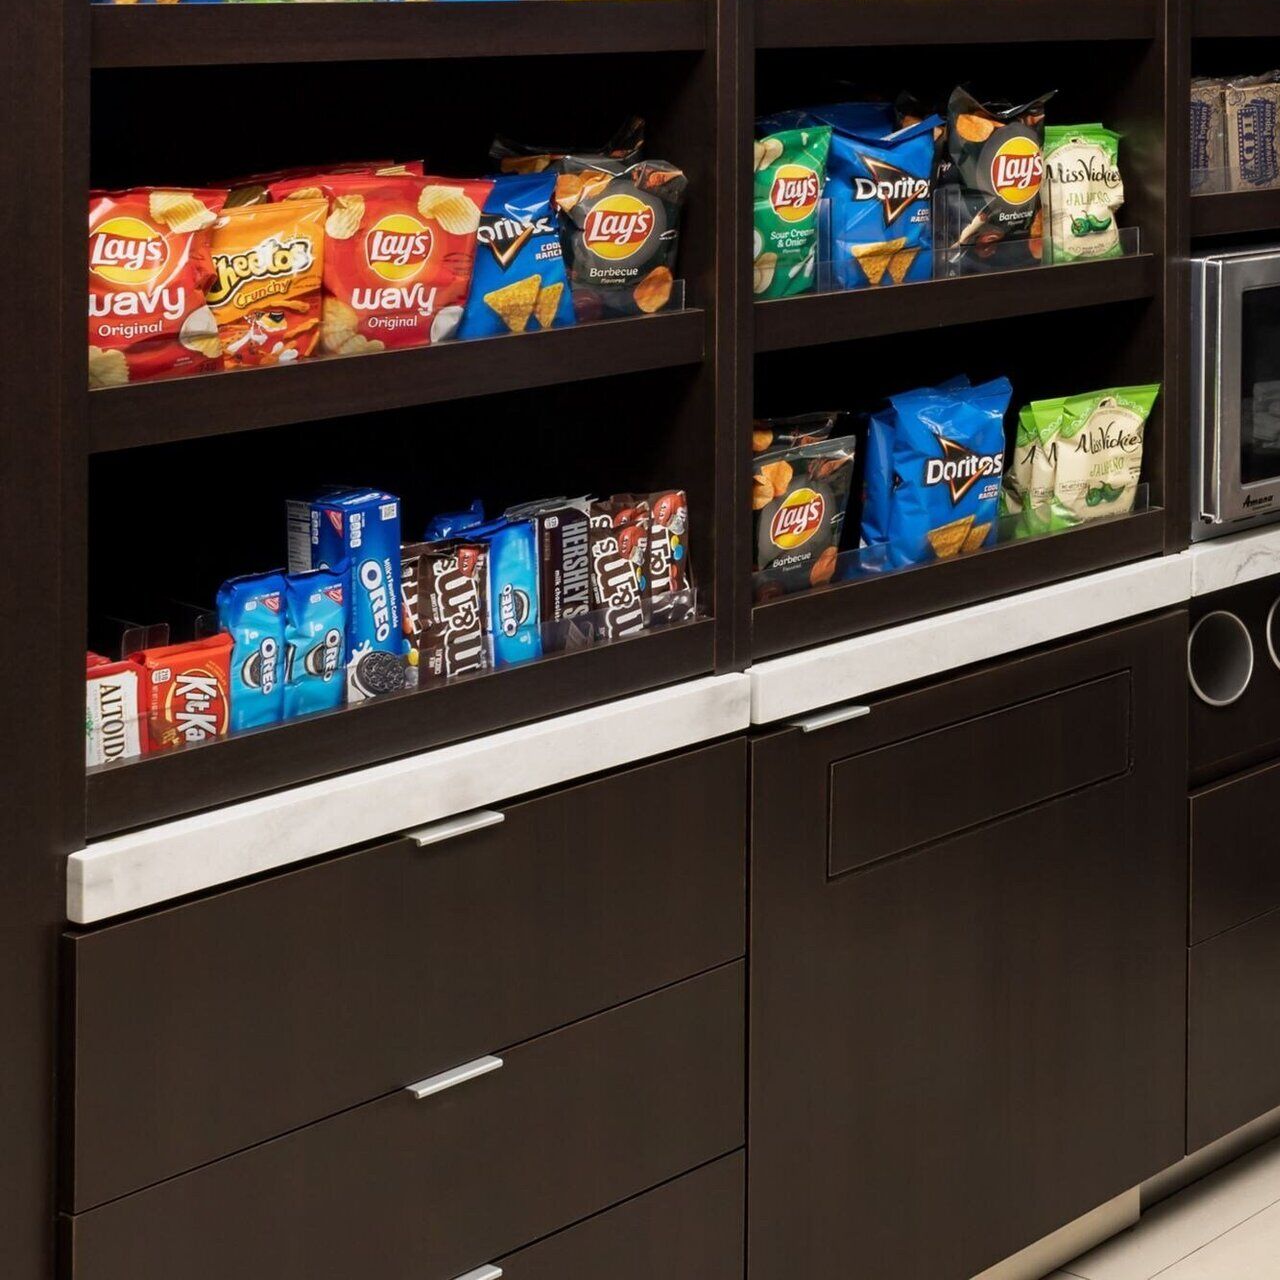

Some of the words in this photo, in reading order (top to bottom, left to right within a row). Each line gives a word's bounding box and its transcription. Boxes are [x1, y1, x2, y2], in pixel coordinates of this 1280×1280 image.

[997, 152, 1043, 190] Lay's
[775, 177, 817, 208] Lay's
[477, 216, 554, 243] oritos
[588, 211, 650, 246] Lay's
[770, 230, 788, 241] Sour
[91, 234, 163, 270] Lay's
[371, 230, 428, 266] Lay's
[589, 267, 638, 277] Barbecue
[234, 279, 292, 309] Crunchy
[352, 283, 437, 316] wavy
[99, 321, 163, 339] Original
[368, 315, 418, 331] Original
[926, 453, 1003, 485] Doritos
[774, 500, 821, 536] Lay's
[562, 521, 590, 620] HERSHEY'S
[773, 552, 812, 568] Barbecue
[359, 559, 391, 643] OREO
[501, 584, 518, 637] OREO
[260, 637, 279, 695] OREO
[324, 629, 342, 682] OREO
[175, 674, 218, 743] KitKa
